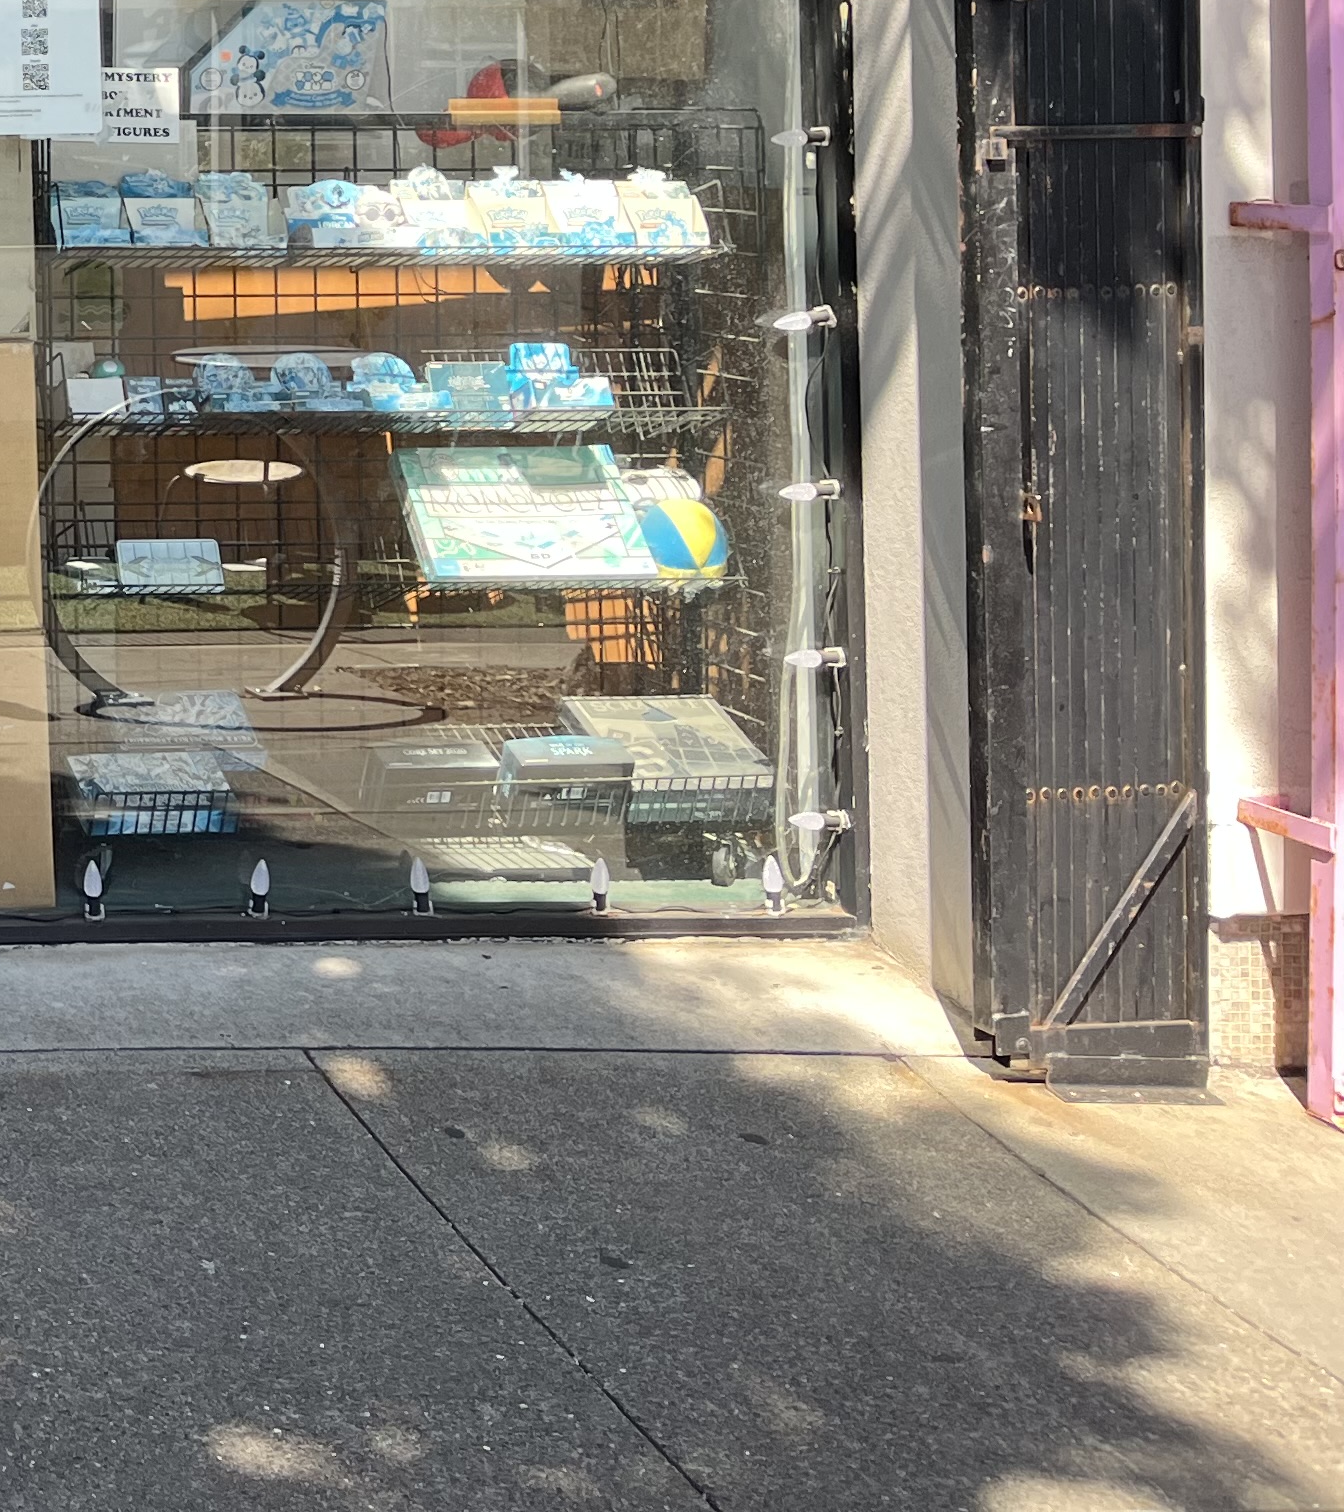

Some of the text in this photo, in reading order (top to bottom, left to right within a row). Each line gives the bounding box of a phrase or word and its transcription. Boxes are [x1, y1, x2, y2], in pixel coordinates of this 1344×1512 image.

[104, 72, 172, 83] MYSTERY
[428, 488, 606, 514] MONOPOLY
[550, 746, 593, 757] SPARK
